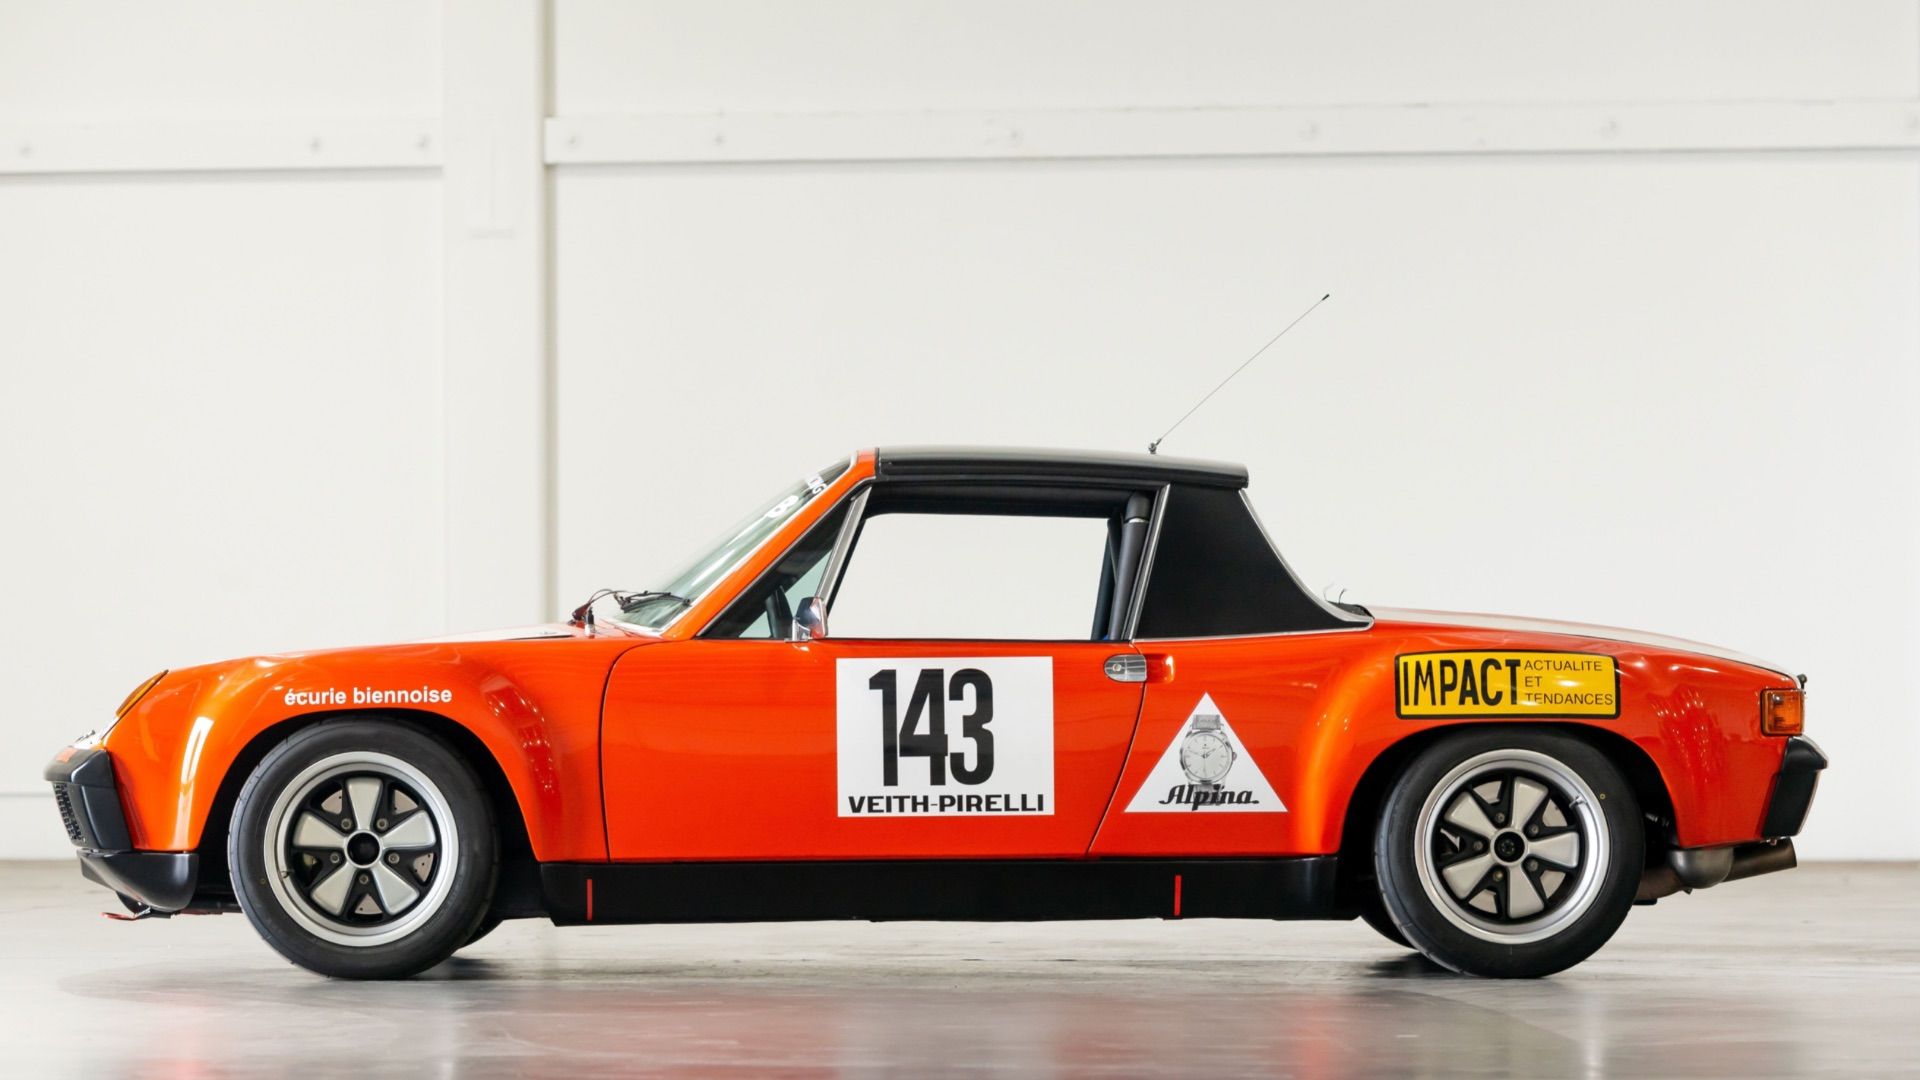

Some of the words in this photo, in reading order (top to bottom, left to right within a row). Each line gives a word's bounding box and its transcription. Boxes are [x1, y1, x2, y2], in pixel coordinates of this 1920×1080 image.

[1524, 659, 1602, 671] ACTUALITE
[1403, 658, 1521, 706] IMPACT
[1525, 676, 1542, 688] ET
[284, 688, 346, 705] écurie
[353, 686, 452, 704] biennoise
[1525, 692, 1613, 706] TENDANCES
[869, 668, 994, 786] 143
[848, 794, 1044, 813] VEITH-PIRELLI
[1158, 783, 1260, 811] Alpina
